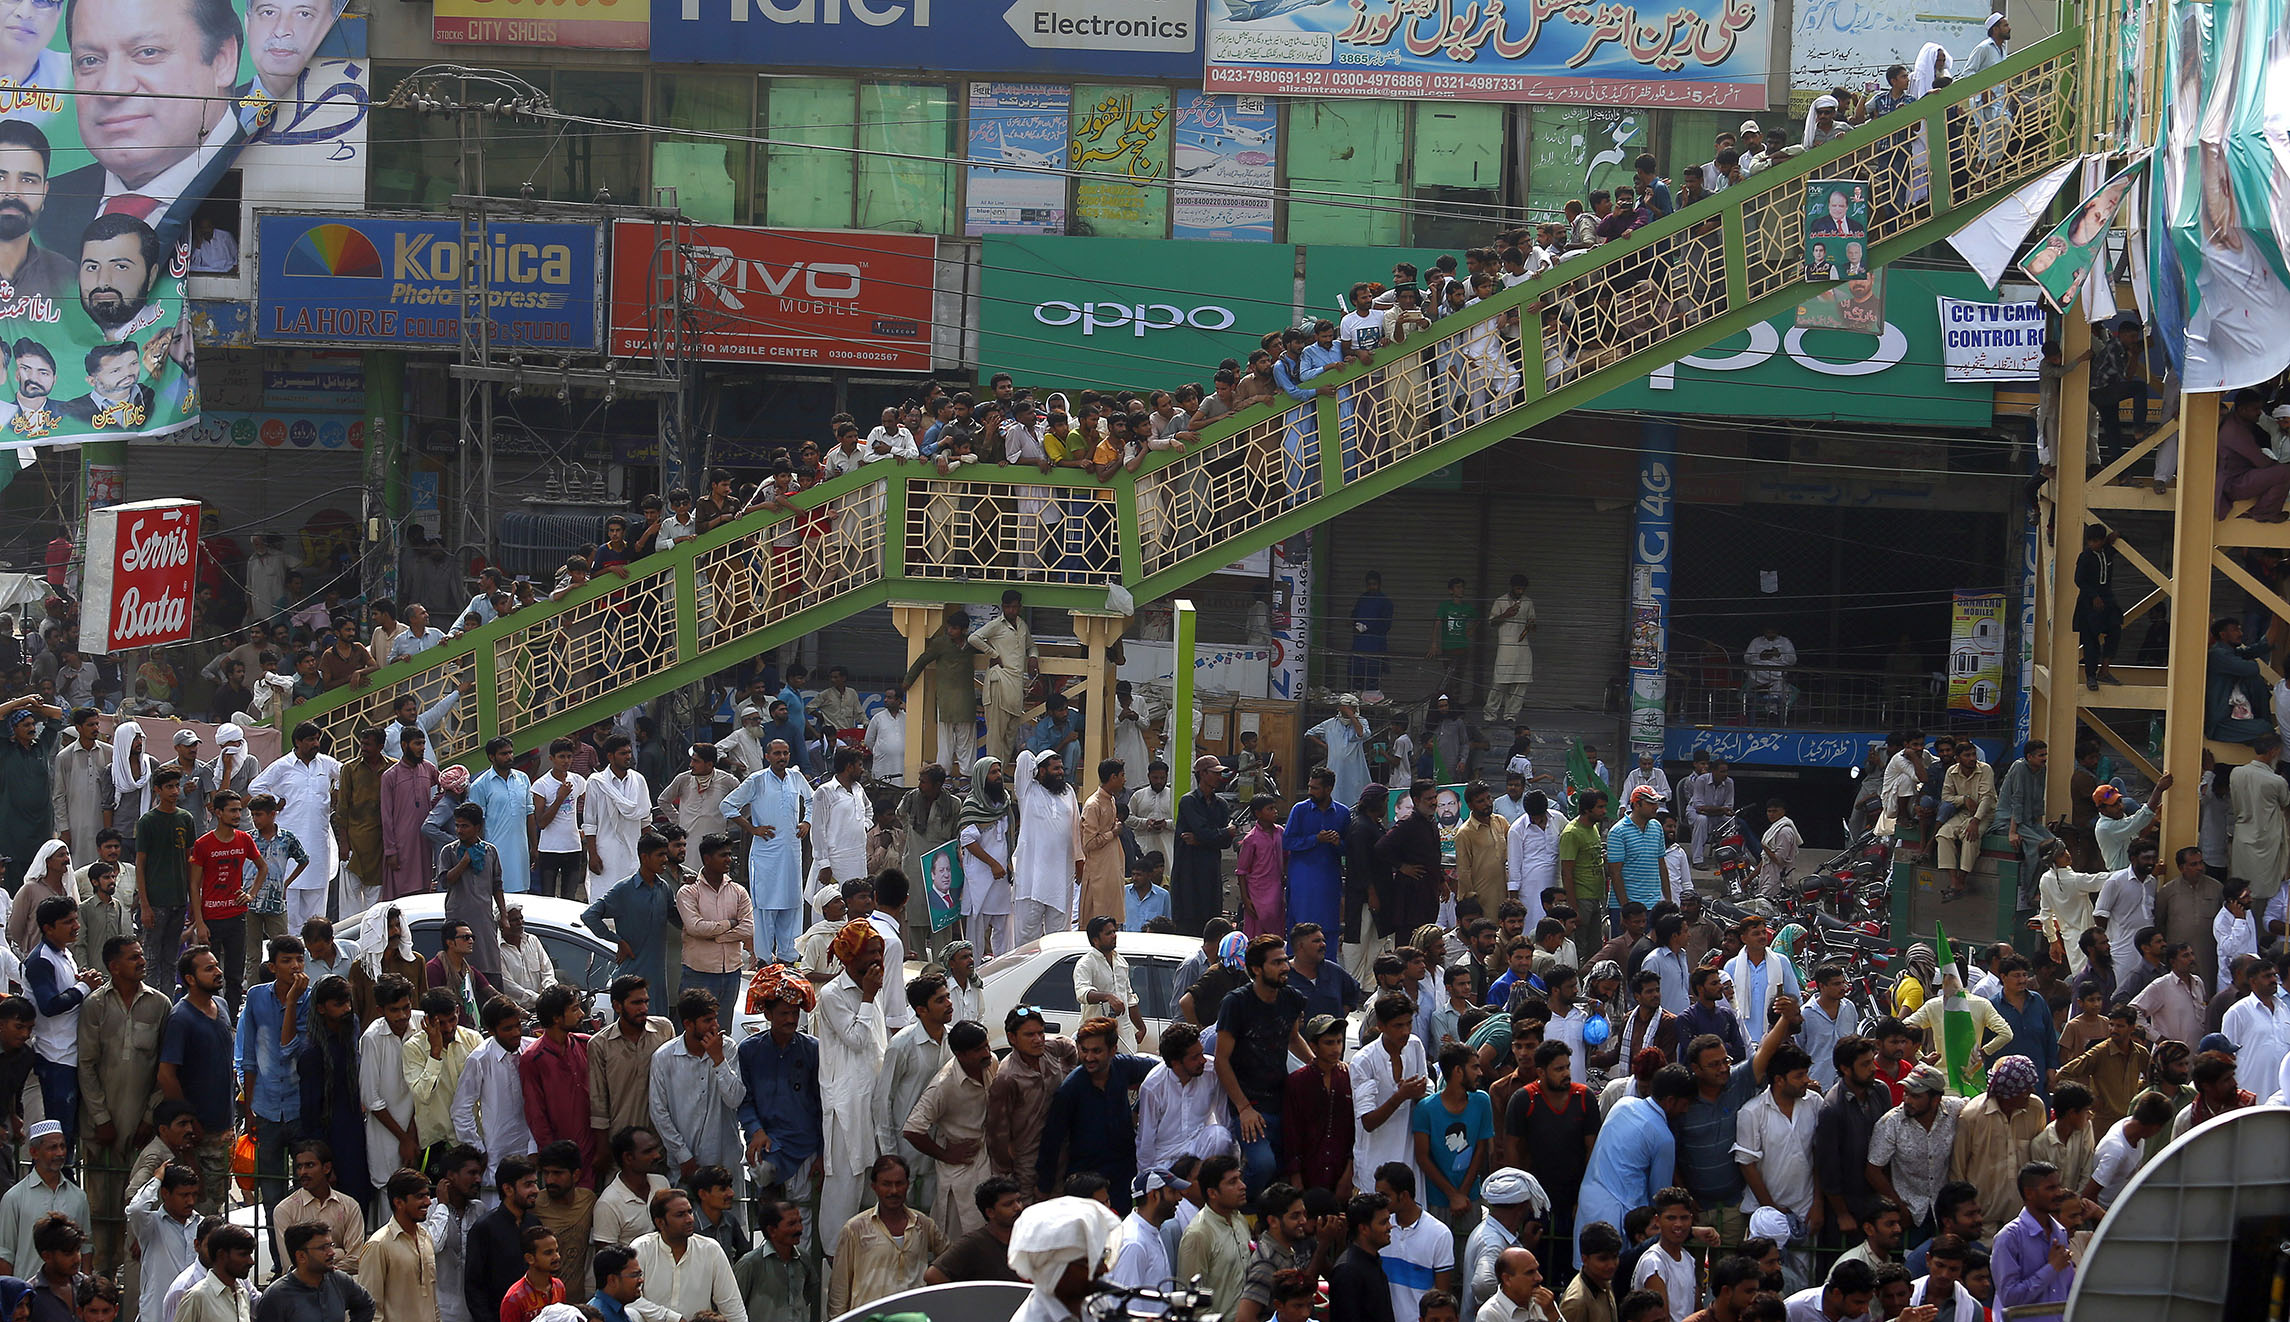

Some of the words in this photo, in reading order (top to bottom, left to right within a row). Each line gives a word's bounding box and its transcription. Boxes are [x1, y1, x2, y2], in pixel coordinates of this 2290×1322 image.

[468, 20, 502, 41] CITY
[508, 21, 557, 42] SHOES
[1034, 12, 1188, 39] Electronics
[1628, 7, 1697, 70] زین
[1339, 53, 1368, 65] 3865
[1368, 51, 1385, 66] نمبر
[1211, 69, 1322, 85] 0423-7980691-92
[1333, 73, 1423, 88] 0300-4976886
[1434, 76, 1523, 91] 0321-4987331
[1278, 86, 1455, 97] alizaintravelmdk@gmail.com
[1692, 91, 1702, 102] 5
[1701, 85, 1718, 103] نمبر
[394, 232, 571, 285] Konica
[682, 246, 861, 310] RIVO
[390, 284, 453, 306] Photo
[780, 299, 859, 316] MOBILE
[1033, 300, 1235, 337] oppo
[1951, 305, 1975, 322] CC
[1978, 305, 1999, 322] TV
[2004, 304, 2046, 322] CAM
[275, 305, 398, 337] LAHORE
[405, 317, 458, 338] COLOR
[511, 321, 571, 341] STUDIO
[1948, 329, 2023, 348] CONTROL
[719, 344, 765, 355] MOBILE
[770, 347, 818, 358] CENTER
[829, 350, 898, 361] 0300-8002567
[1639, 463, 1672, 517] 4G
[122, 518, 189, 572] Servis
[1297, 569, 1308, 614] 3G+4G
[114, 586, 185, 641] Bata
[1963, 608, 1994, 617] MOBILES
[1296, 619, 1308, 649] Only
[1294, 653, 1305, 662] &
